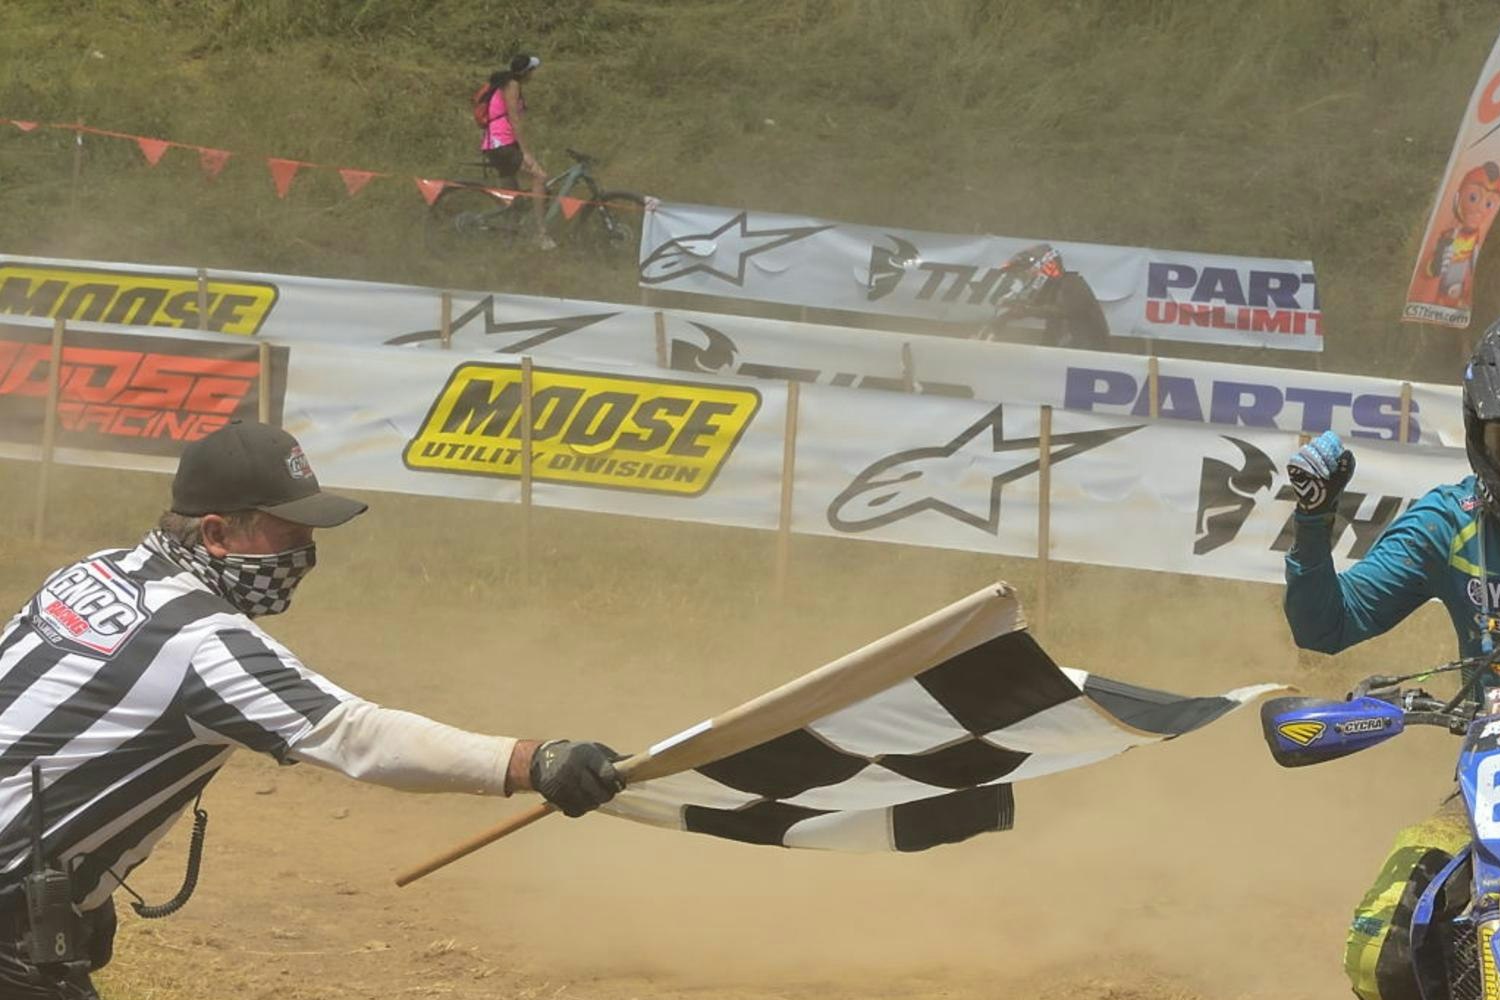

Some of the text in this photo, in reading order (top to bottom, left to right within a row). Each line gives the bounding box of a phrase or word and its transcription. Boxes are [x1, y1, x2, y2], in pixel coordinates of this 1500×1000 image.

[441, 378, 738, 458] MOOSE
[1064, 366, 1422, 444] PARTS
[546, 453, 701, 484] DIVISION
[44, 600, 90, 637] RACING
[46, 566, 138, 636] GNCC
[1344, 720, 1383, 733] CYCRA
[54, 932, 66, 956] 8
